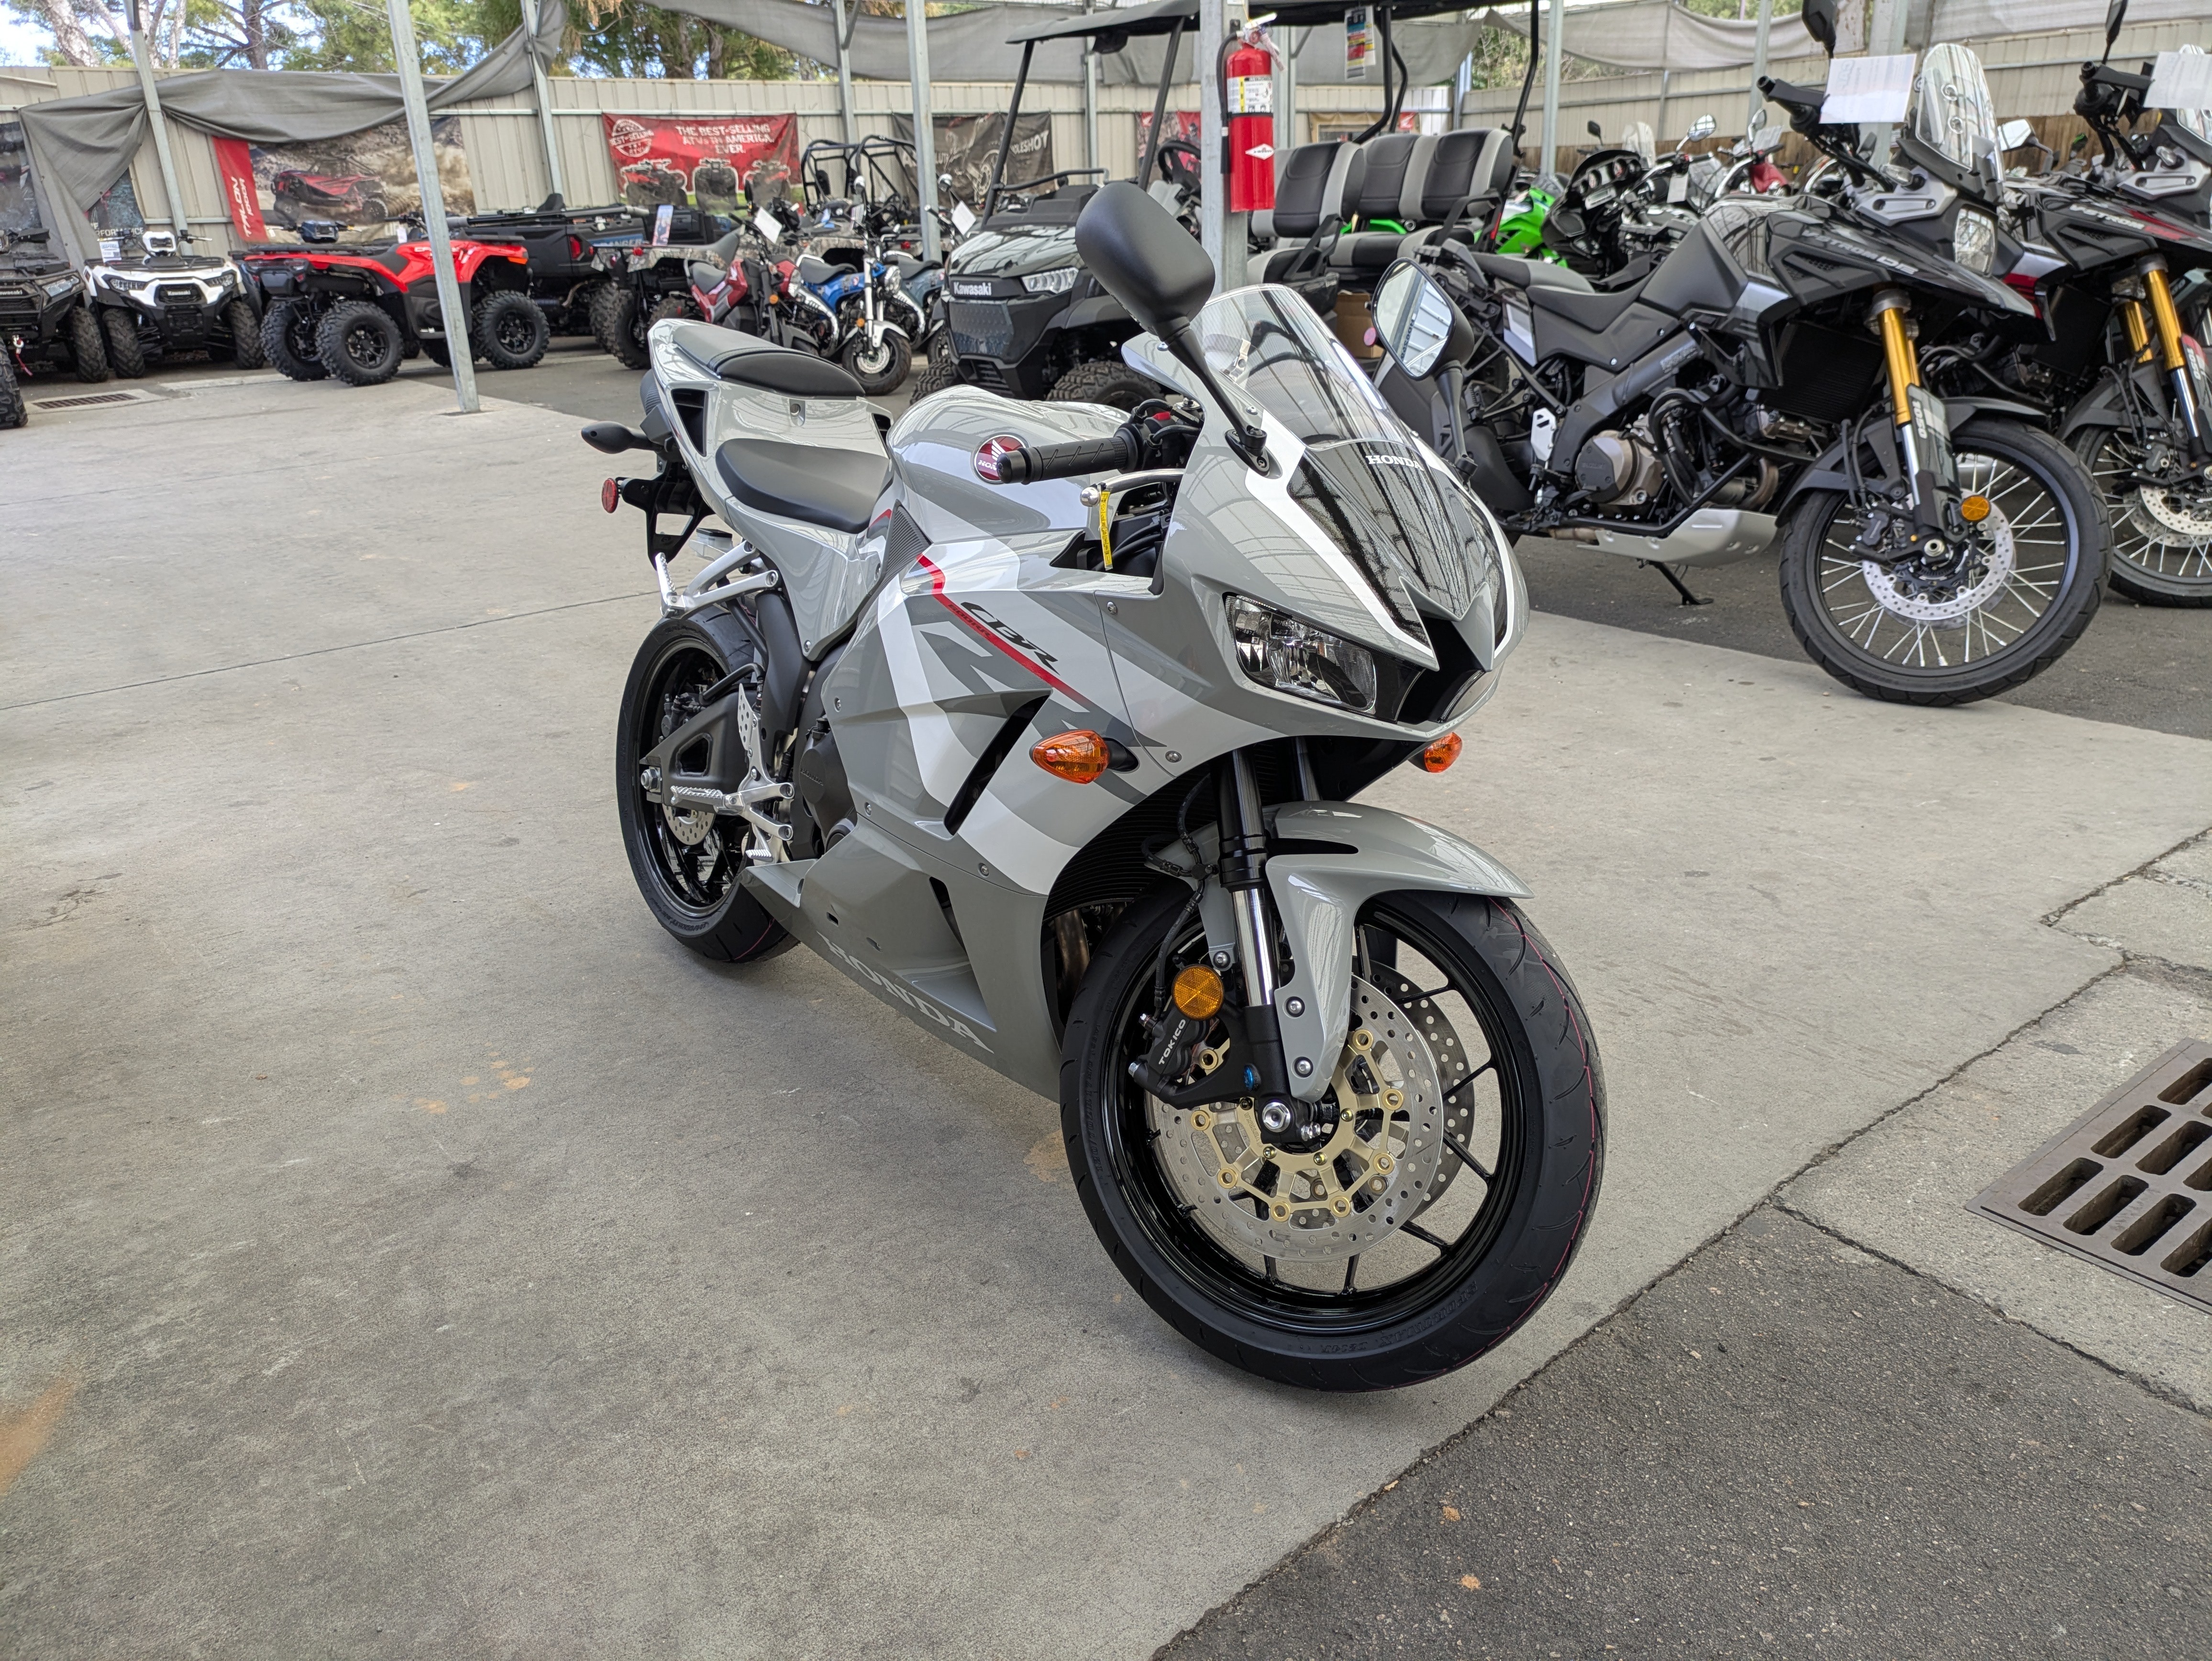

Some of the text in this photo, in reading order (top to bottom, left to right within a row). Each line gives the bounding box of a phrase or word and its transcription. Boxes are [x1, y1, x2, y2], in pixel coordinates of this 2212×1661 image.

[675, 123, 771, 137] THE BEST-SELLING
[231, 176, 252, 238] TALON
[1802, 230, 1879, 260] V-STROM
[953, 281, 992, 296] Kawasaki
[2186, 347, 2201, 380] 1050
[1912, 400, 1927, 439] 1050
[1365, 454, 1425, 471] HONDA
[961, 601, 1061, 676] CBR
[800, 767, 824, 786] HONDA
[816, 930, 995, 1054] HONDA
[1158, 1019, 1186, 1066] TOKICO
[1244, 1111, 1261, 1142] YUTAKA
